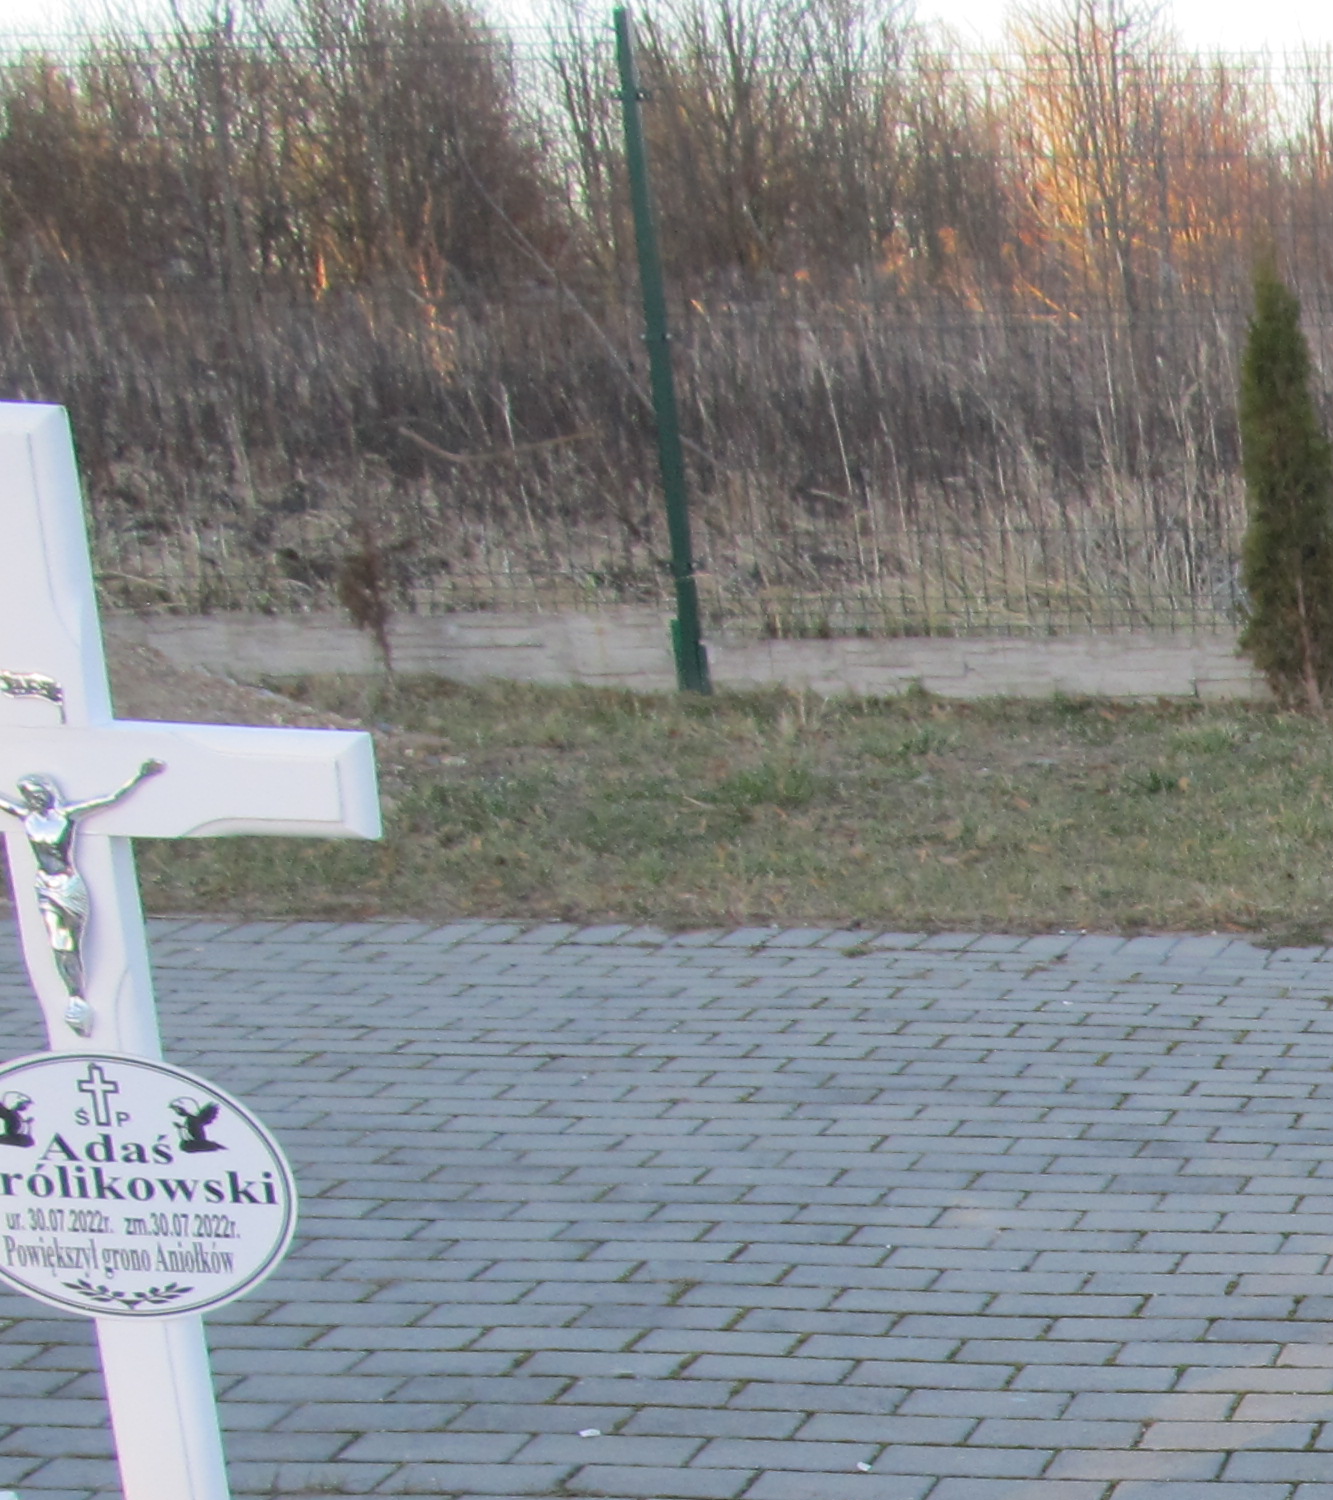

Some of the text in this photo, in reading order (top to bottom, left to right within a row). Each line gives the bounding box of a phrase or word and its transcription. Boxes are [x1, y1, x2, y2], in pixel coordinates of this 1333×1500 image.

[40, 1132, 174, 1164] Adaś
[0, 1163, 279, 1205] rólikowski
[101, 1247, 151, 1280] grono
